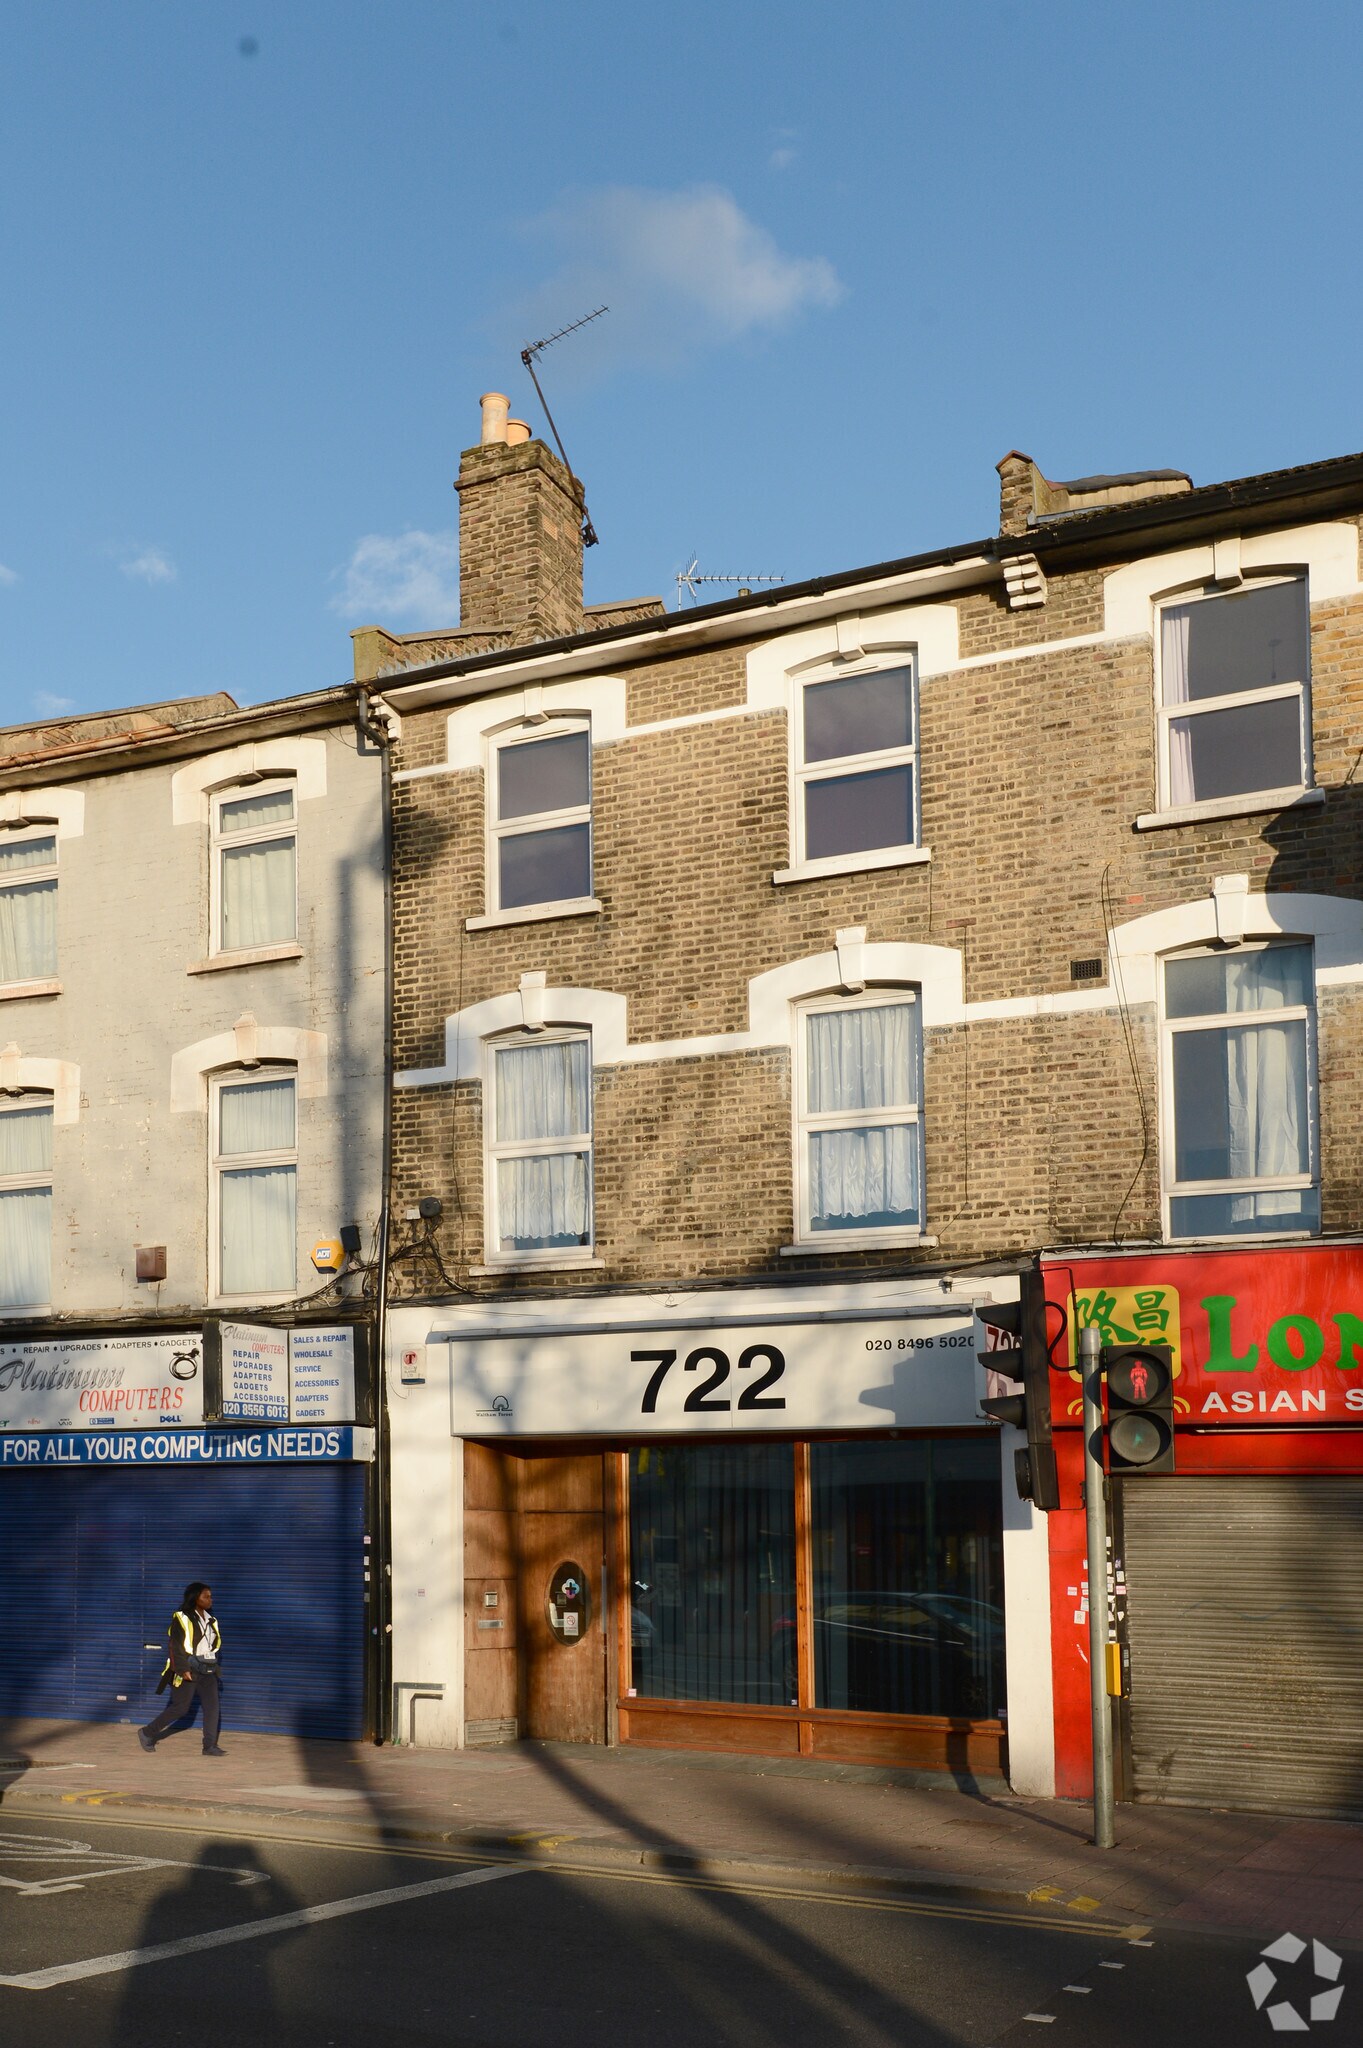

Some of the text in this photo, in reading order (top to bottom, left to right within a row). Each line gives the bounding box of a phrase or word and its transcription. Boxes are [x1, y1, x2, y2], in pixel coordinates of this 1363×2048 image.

[316, 1250, 330, 1258] ADT
[293, 1336, 314, 1344] SALES
[322, 1334, 347, 1342] REPAIR
[23, 1346, 50, 1354] REPAIR
[60, 1343, 102, 1352] UPGRADES
[111, 1341, 152, 1350] ADAPTERS
[159, 1339, 197, 1347] GADGETS
[251, 1342, 285, 1355] COMPUTERS
[865, 1339, 892, 1351] 020
[897, 1338, 934, 1350] 8496
[232, 1350, 260, 1360] REPAIR
[293, 1350, 333, 1358] WHOLESALE
[405, 1354, 416, 1364] T
[232, 1361, 273, 1371] UPGRADES
[294, 1365, 322, 1373] SERVICE
[0, 1358, 125, 1392] Platinum
[233, 1371, 273, 1381] ADAPTERS
[630, 1343, 786, 1413] 722
[233, 1382, 269, 1391] GADGETS
[294, 1379, 340, 1388] ACCESSORIES
[79, 1386, 184, 1412] COMPUTERS
[233, 1393, 285, 1403] ACCESSORIES
[295, 1394, 329, 1402] ADAPTERS
[1201, 1389, 1326, 1413] ASIAN
[223, 1402, 288, 1418] 020 8556 6013
[295, 1409, 325, 1417] GADGETS
[159, 1415, 182, 1423] DELL
[3, 1439, 41, 1462] FOR
[44, 1438, 81, 1461] ALL
[84, 1437, 137, 1460] YOUR
[140, 1434, 263, 1460] COMPUTING
[267, 1431, 340, 1457] NEEDS
